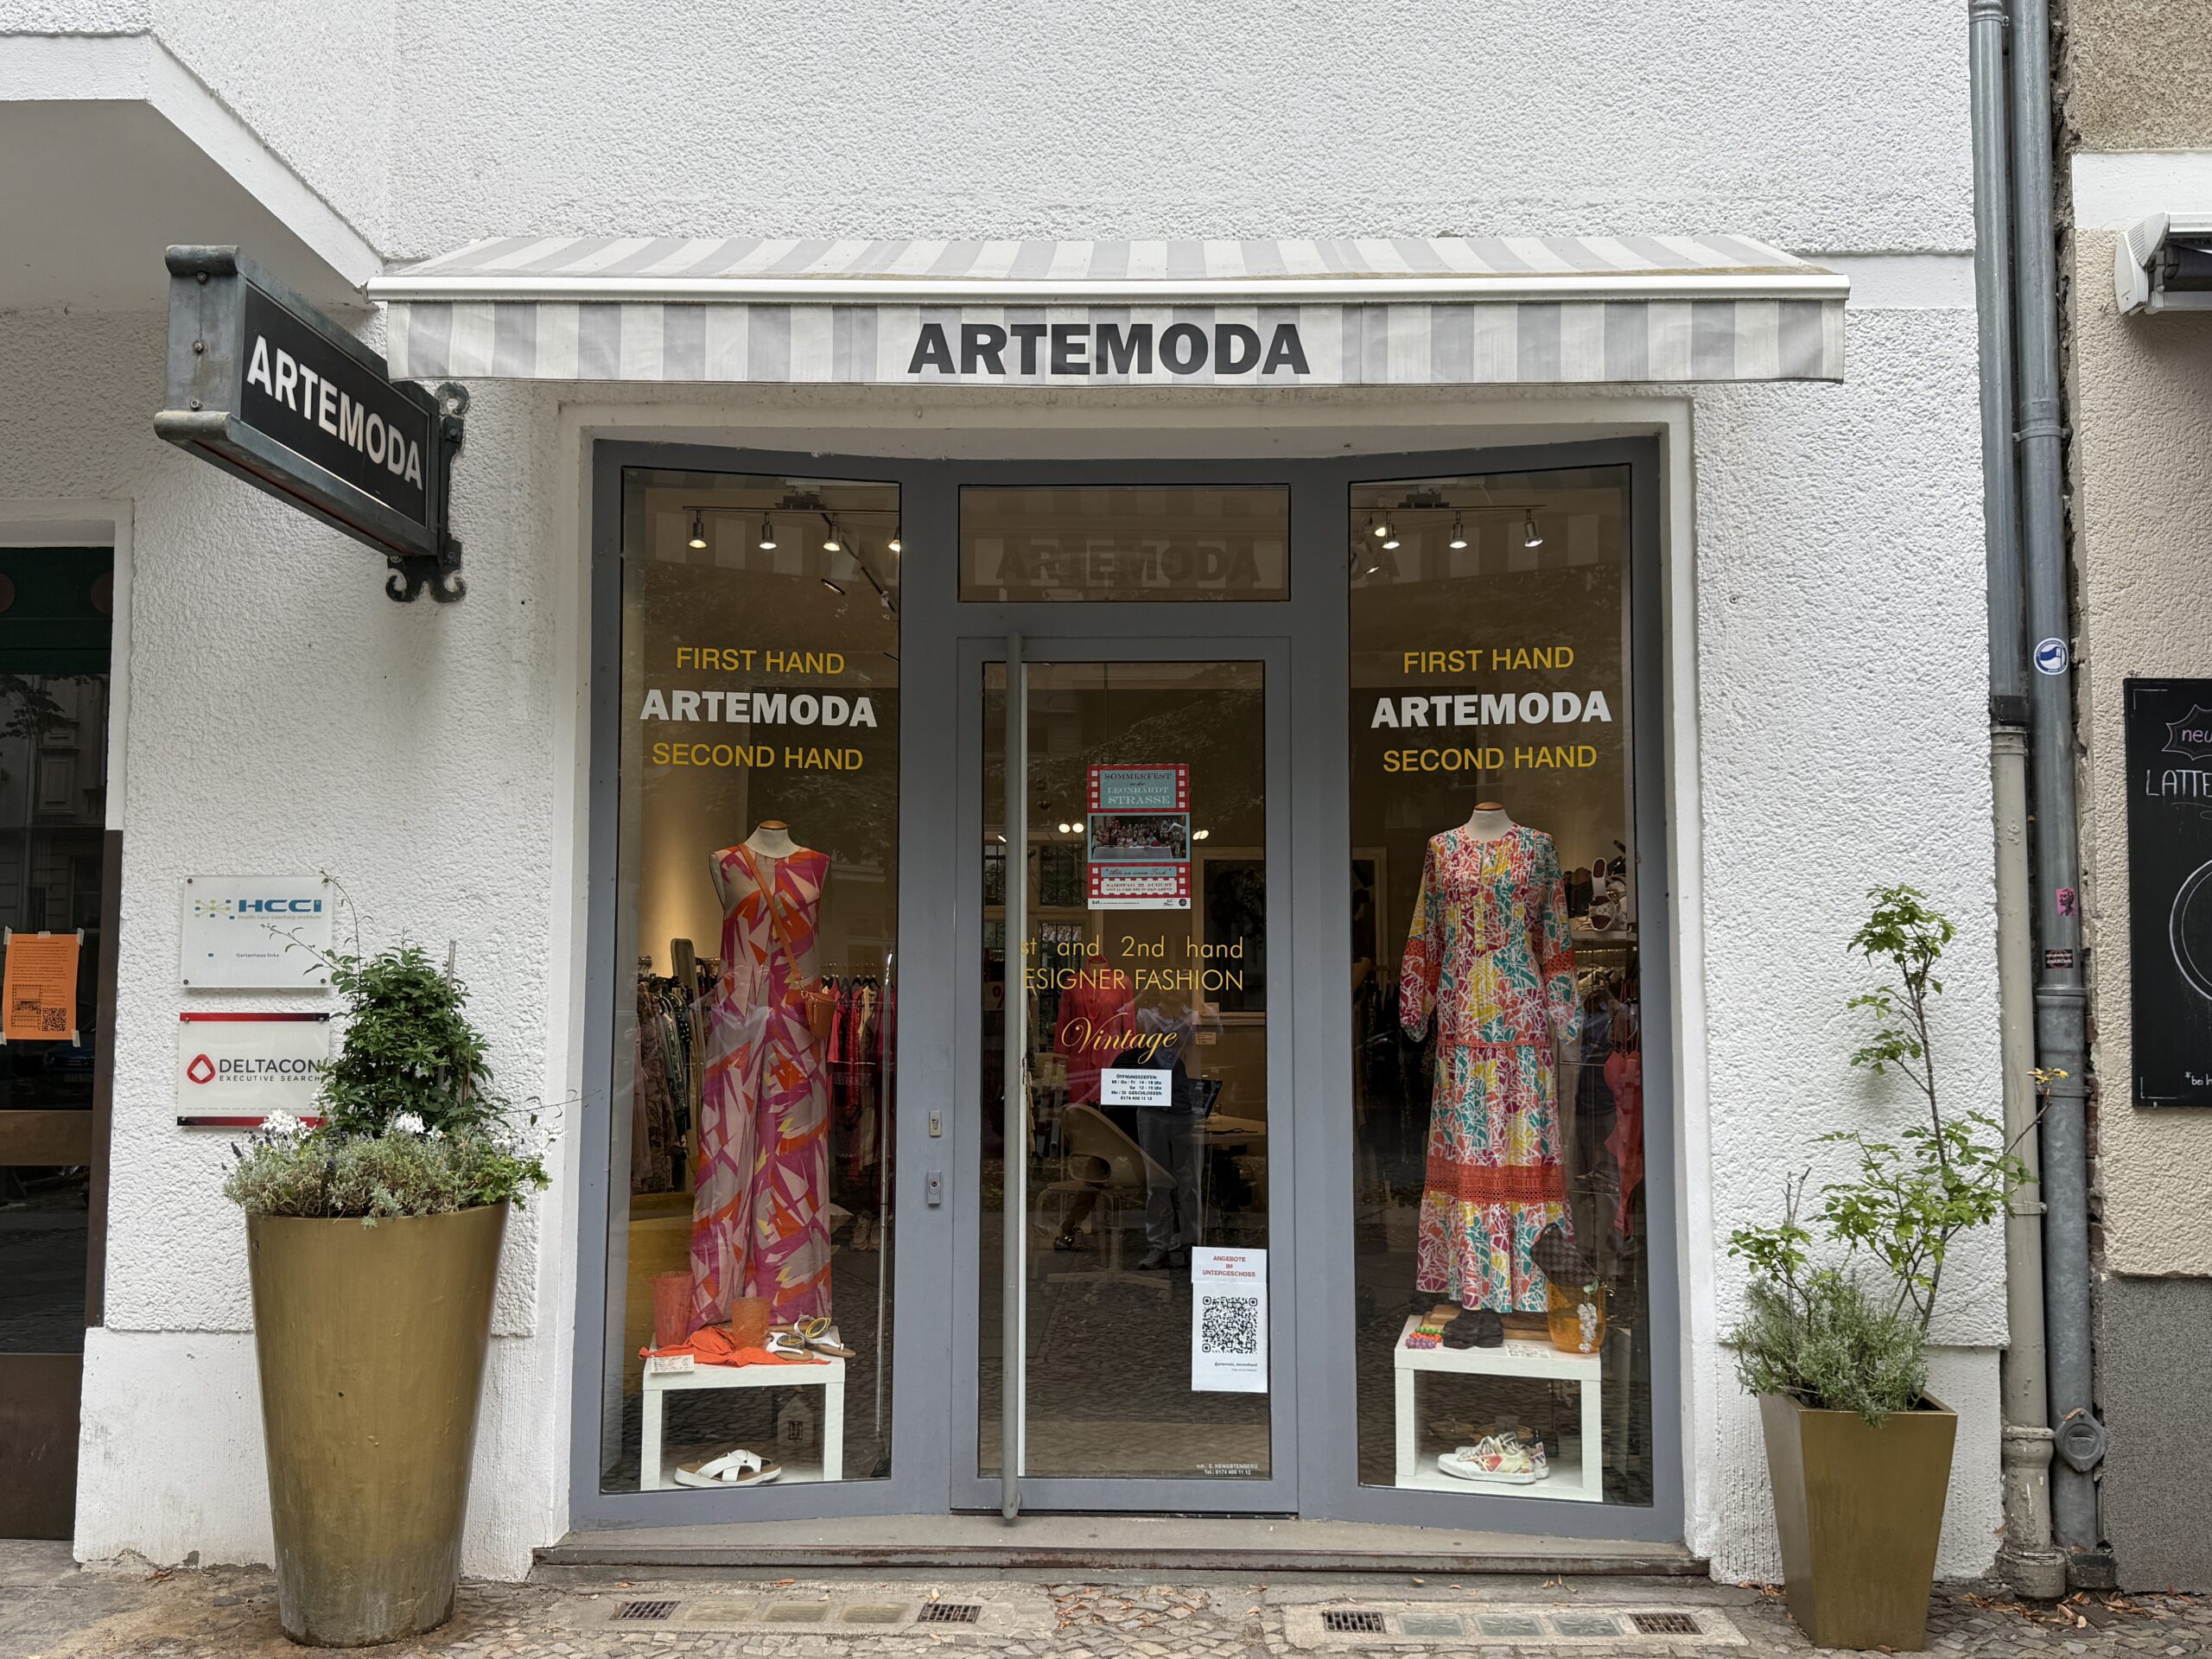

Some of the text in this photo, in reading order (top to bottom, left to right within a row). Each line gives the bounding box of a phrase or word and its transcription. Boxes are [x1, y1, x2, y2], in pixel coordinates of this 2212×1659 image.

[907, 322, 1311, 375] ARTEMODA
[246, 334, 423, 491] ARTEMODA
[677, 647, 845, 675] FIRST HAND
[1403, 646, 1574, 673] FIRST HAND
[639, 689, 878, 728] ARTEMODA
[1370, 690, 1612, 728] ARTEMODA
[652, 742, 863, 770] SECOND HAND
[1382, 745, 1598, 772] SECOND HAND
[1108, 796, 1170, 804] STRASSE
[238, 899, 322, 912] HCCI
[1020, 935, 1243, 958] st and 2nd hand
[1023, 968, 1243, 991] ESIGNER FASHION
[1061, 1013, 1178, 1064] Vintage
[219, 1058, 321, 1073] DELTACON
